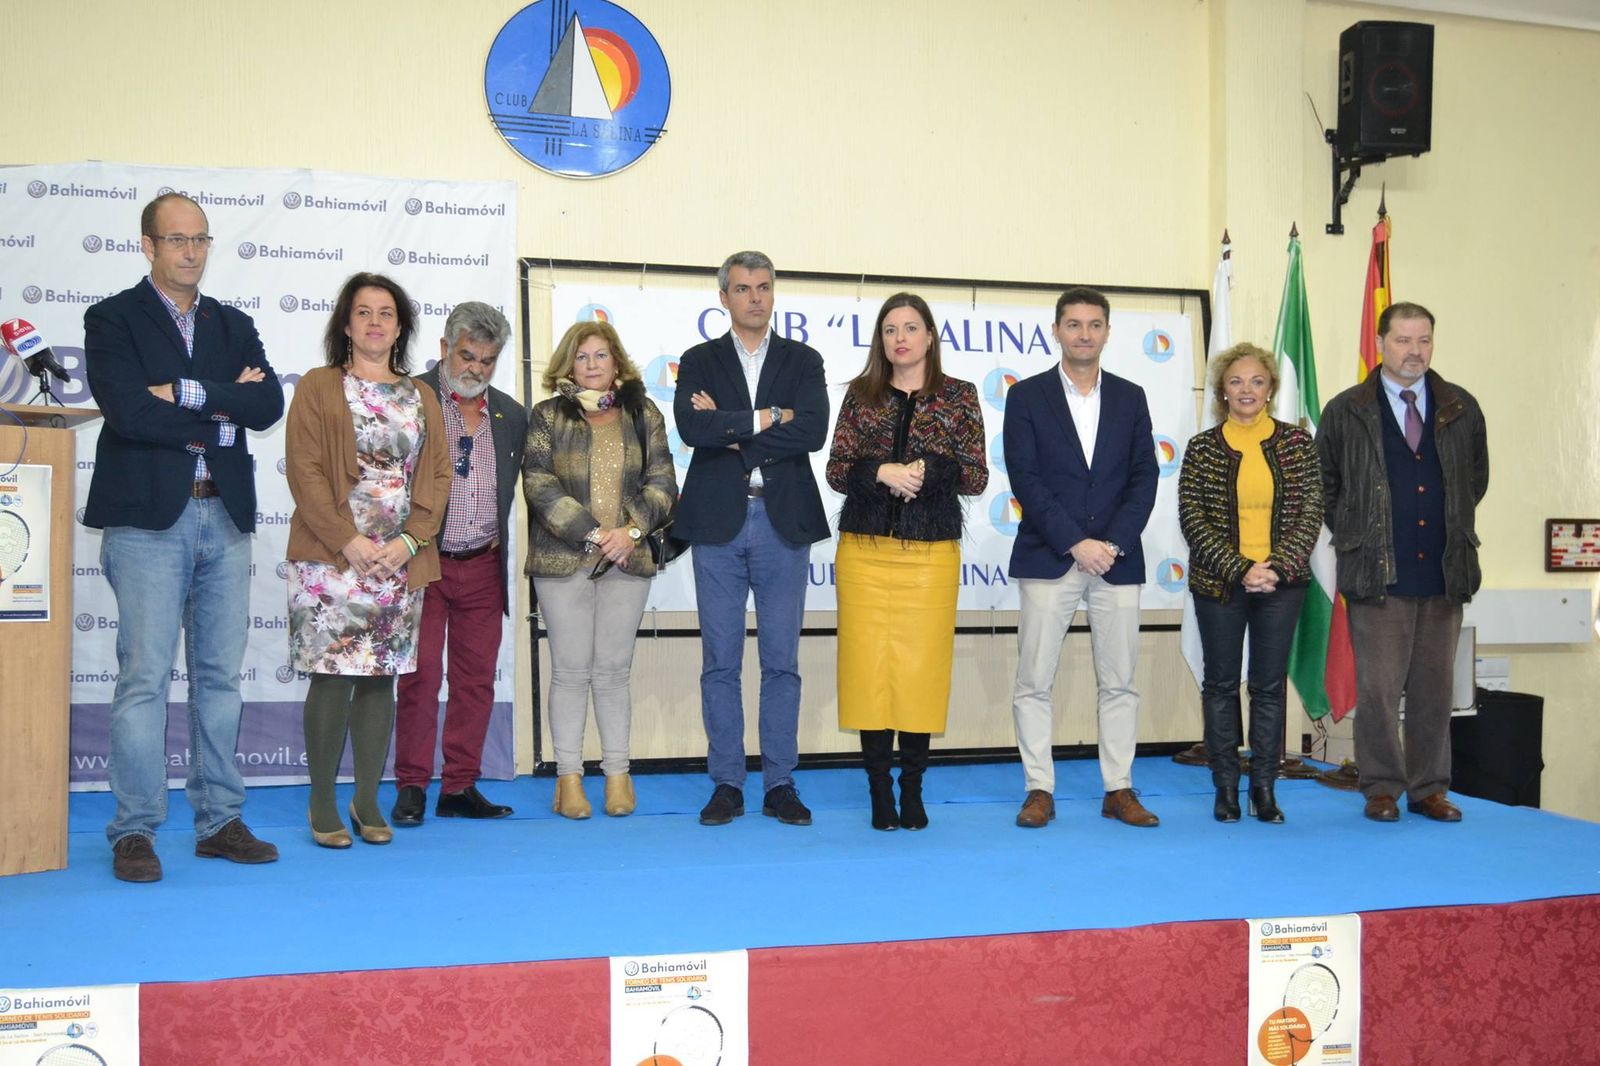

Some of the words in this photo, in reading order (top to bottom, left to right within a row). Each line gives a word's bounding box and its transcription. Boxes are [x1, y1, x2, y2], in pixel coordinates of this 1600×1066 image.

[495, 92, 528, 107] CLUB
[571, 121, 588, 138] LA
[50, 183, 137, 200] Bahiamóvil
[304, 195, 387, 212] Bahiamóvil
[425, 200, 505, 216] Bahiamóvil
[259, 244, 343, 261] Bahiamóvil
[408, 251, 489, 266] Bahiamóvil
[939, 318, 1052, 356] ALINA
[1275, 921, 1328, 933] Bahiamóvil
[641, 959, 707, 973] Bahiamóvil
[14, 994, 90, 1009] Bahiamóvil
